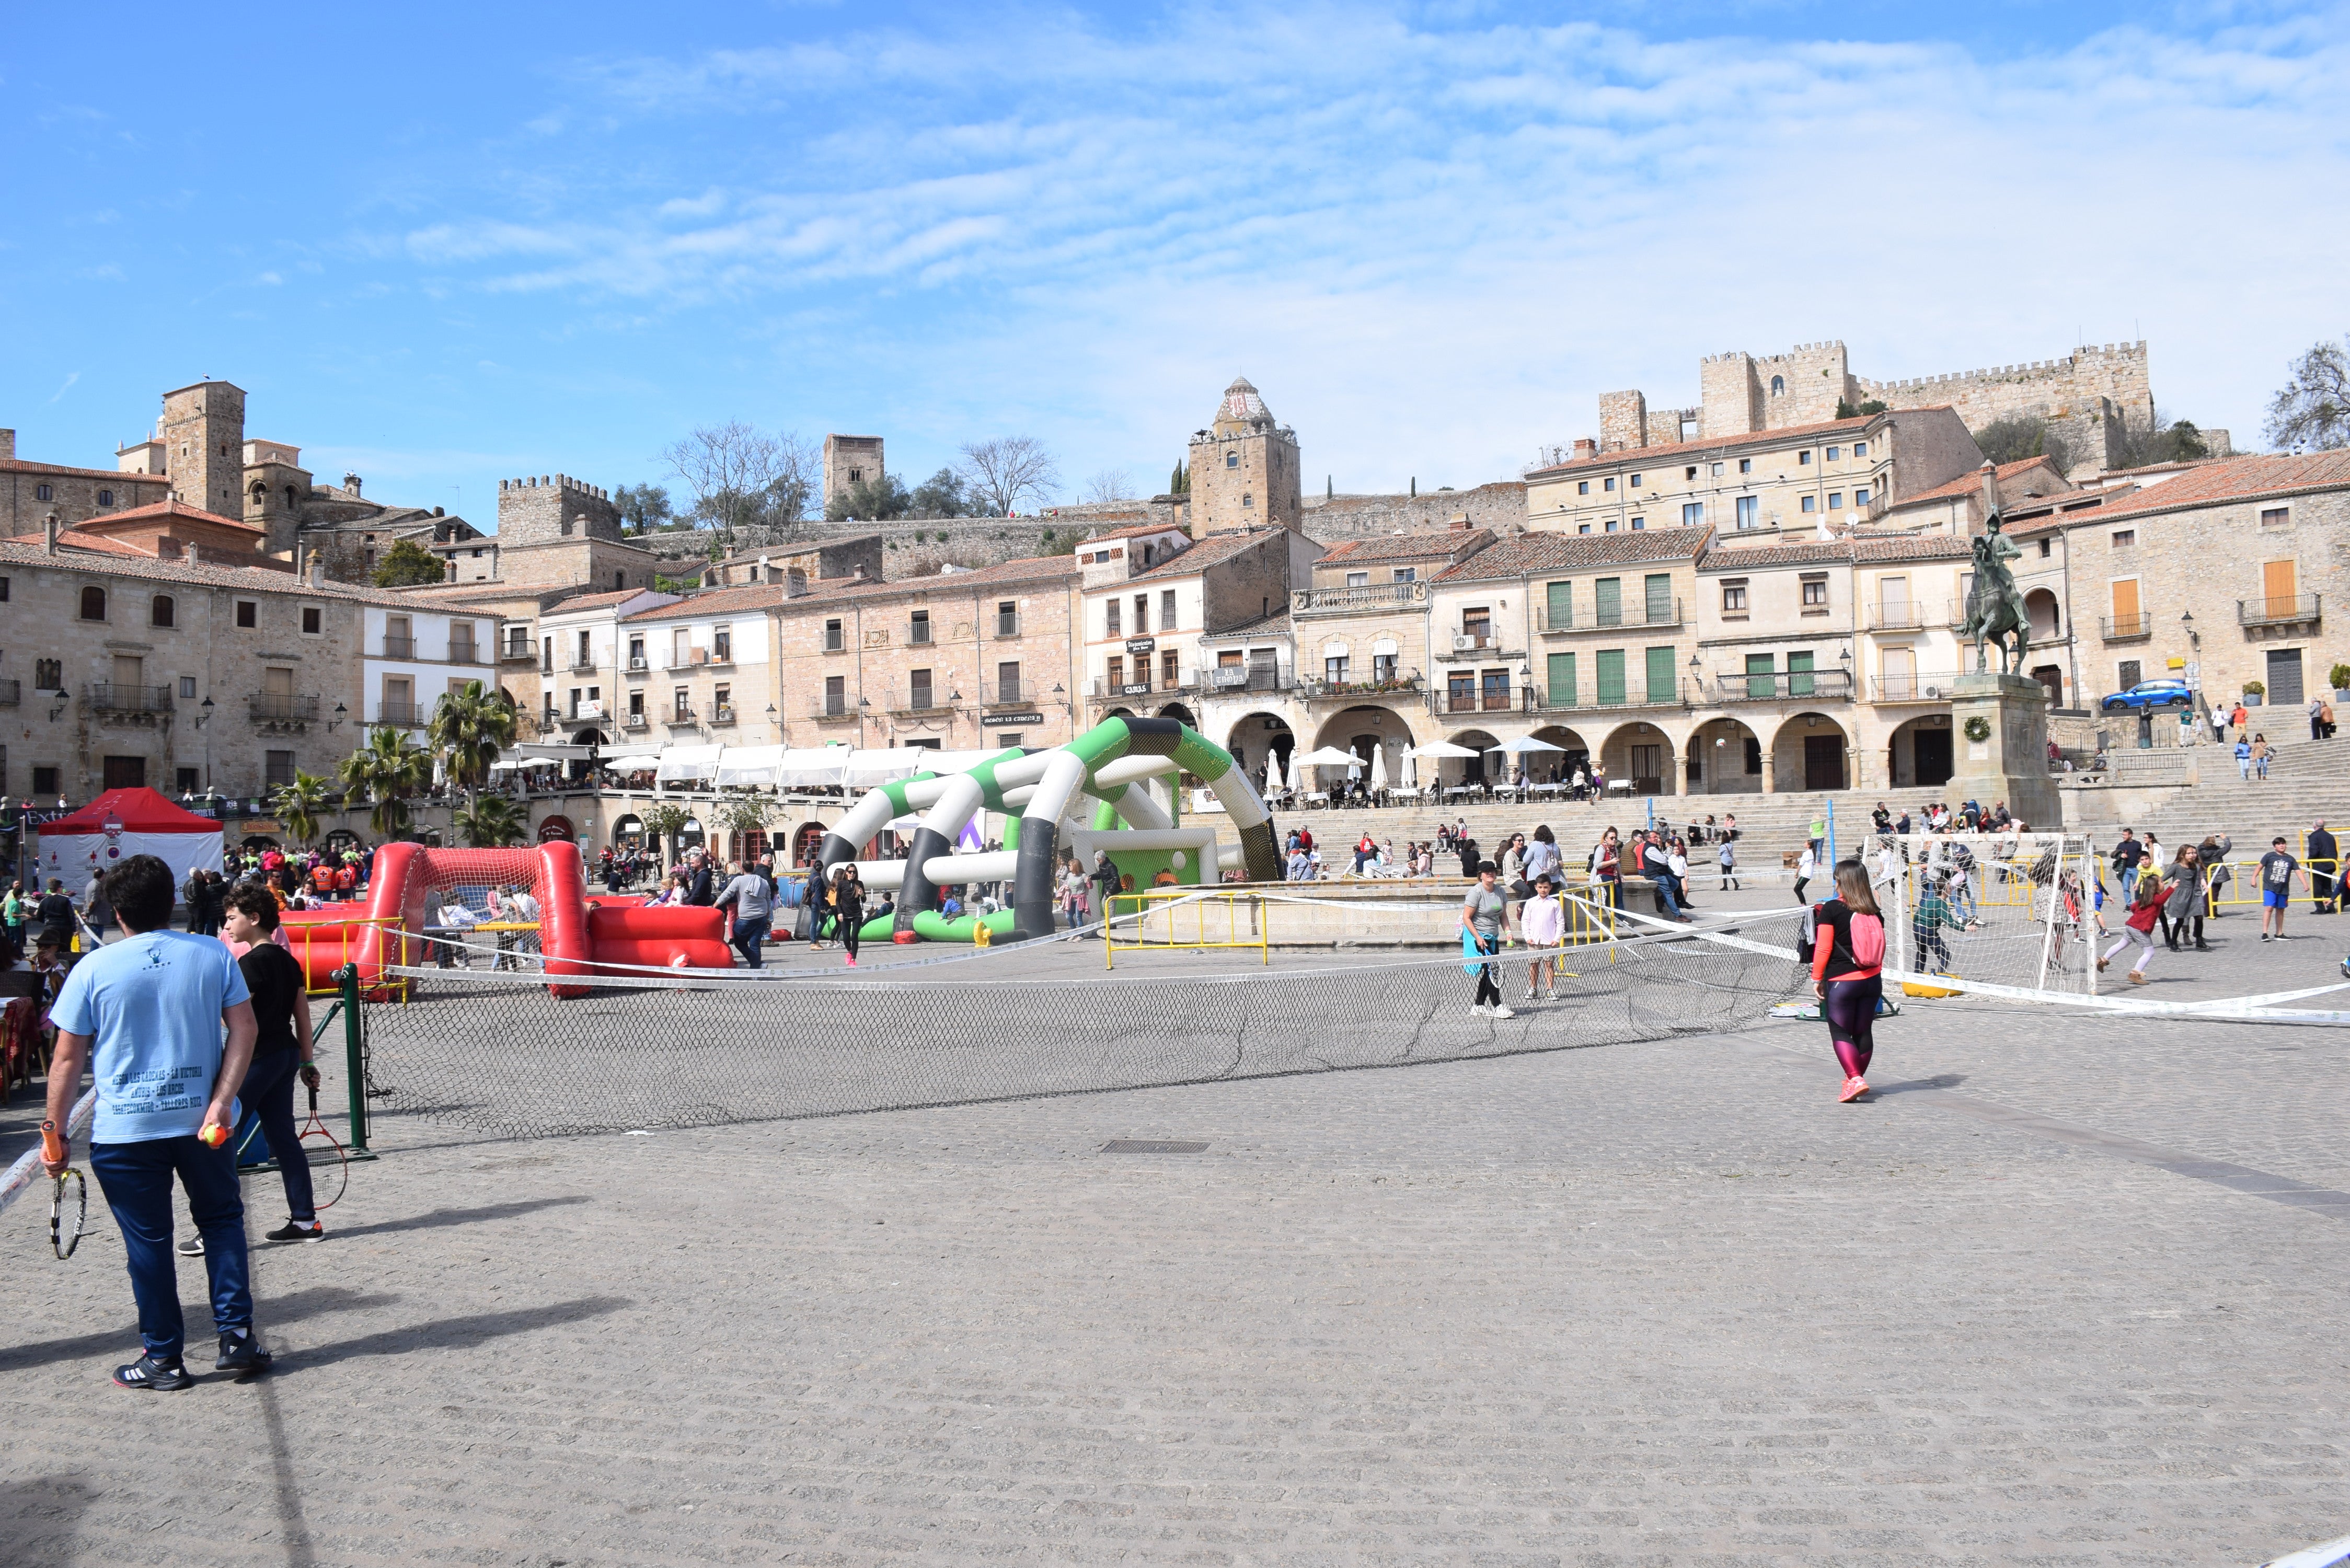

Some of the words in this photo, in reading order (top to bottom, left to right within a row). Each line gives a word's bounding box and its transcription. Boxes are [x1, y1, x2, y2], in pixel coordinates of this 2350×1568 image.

[180, 1066, 202, 1079] VICTORIA
[156, 1085, 166, 1097] LOS
[167, 1082, 185, 1096] ARCOS
[160, 1098, 189, 1112] TALLERES
[189, 1096, 202, 1108] RUIZ
